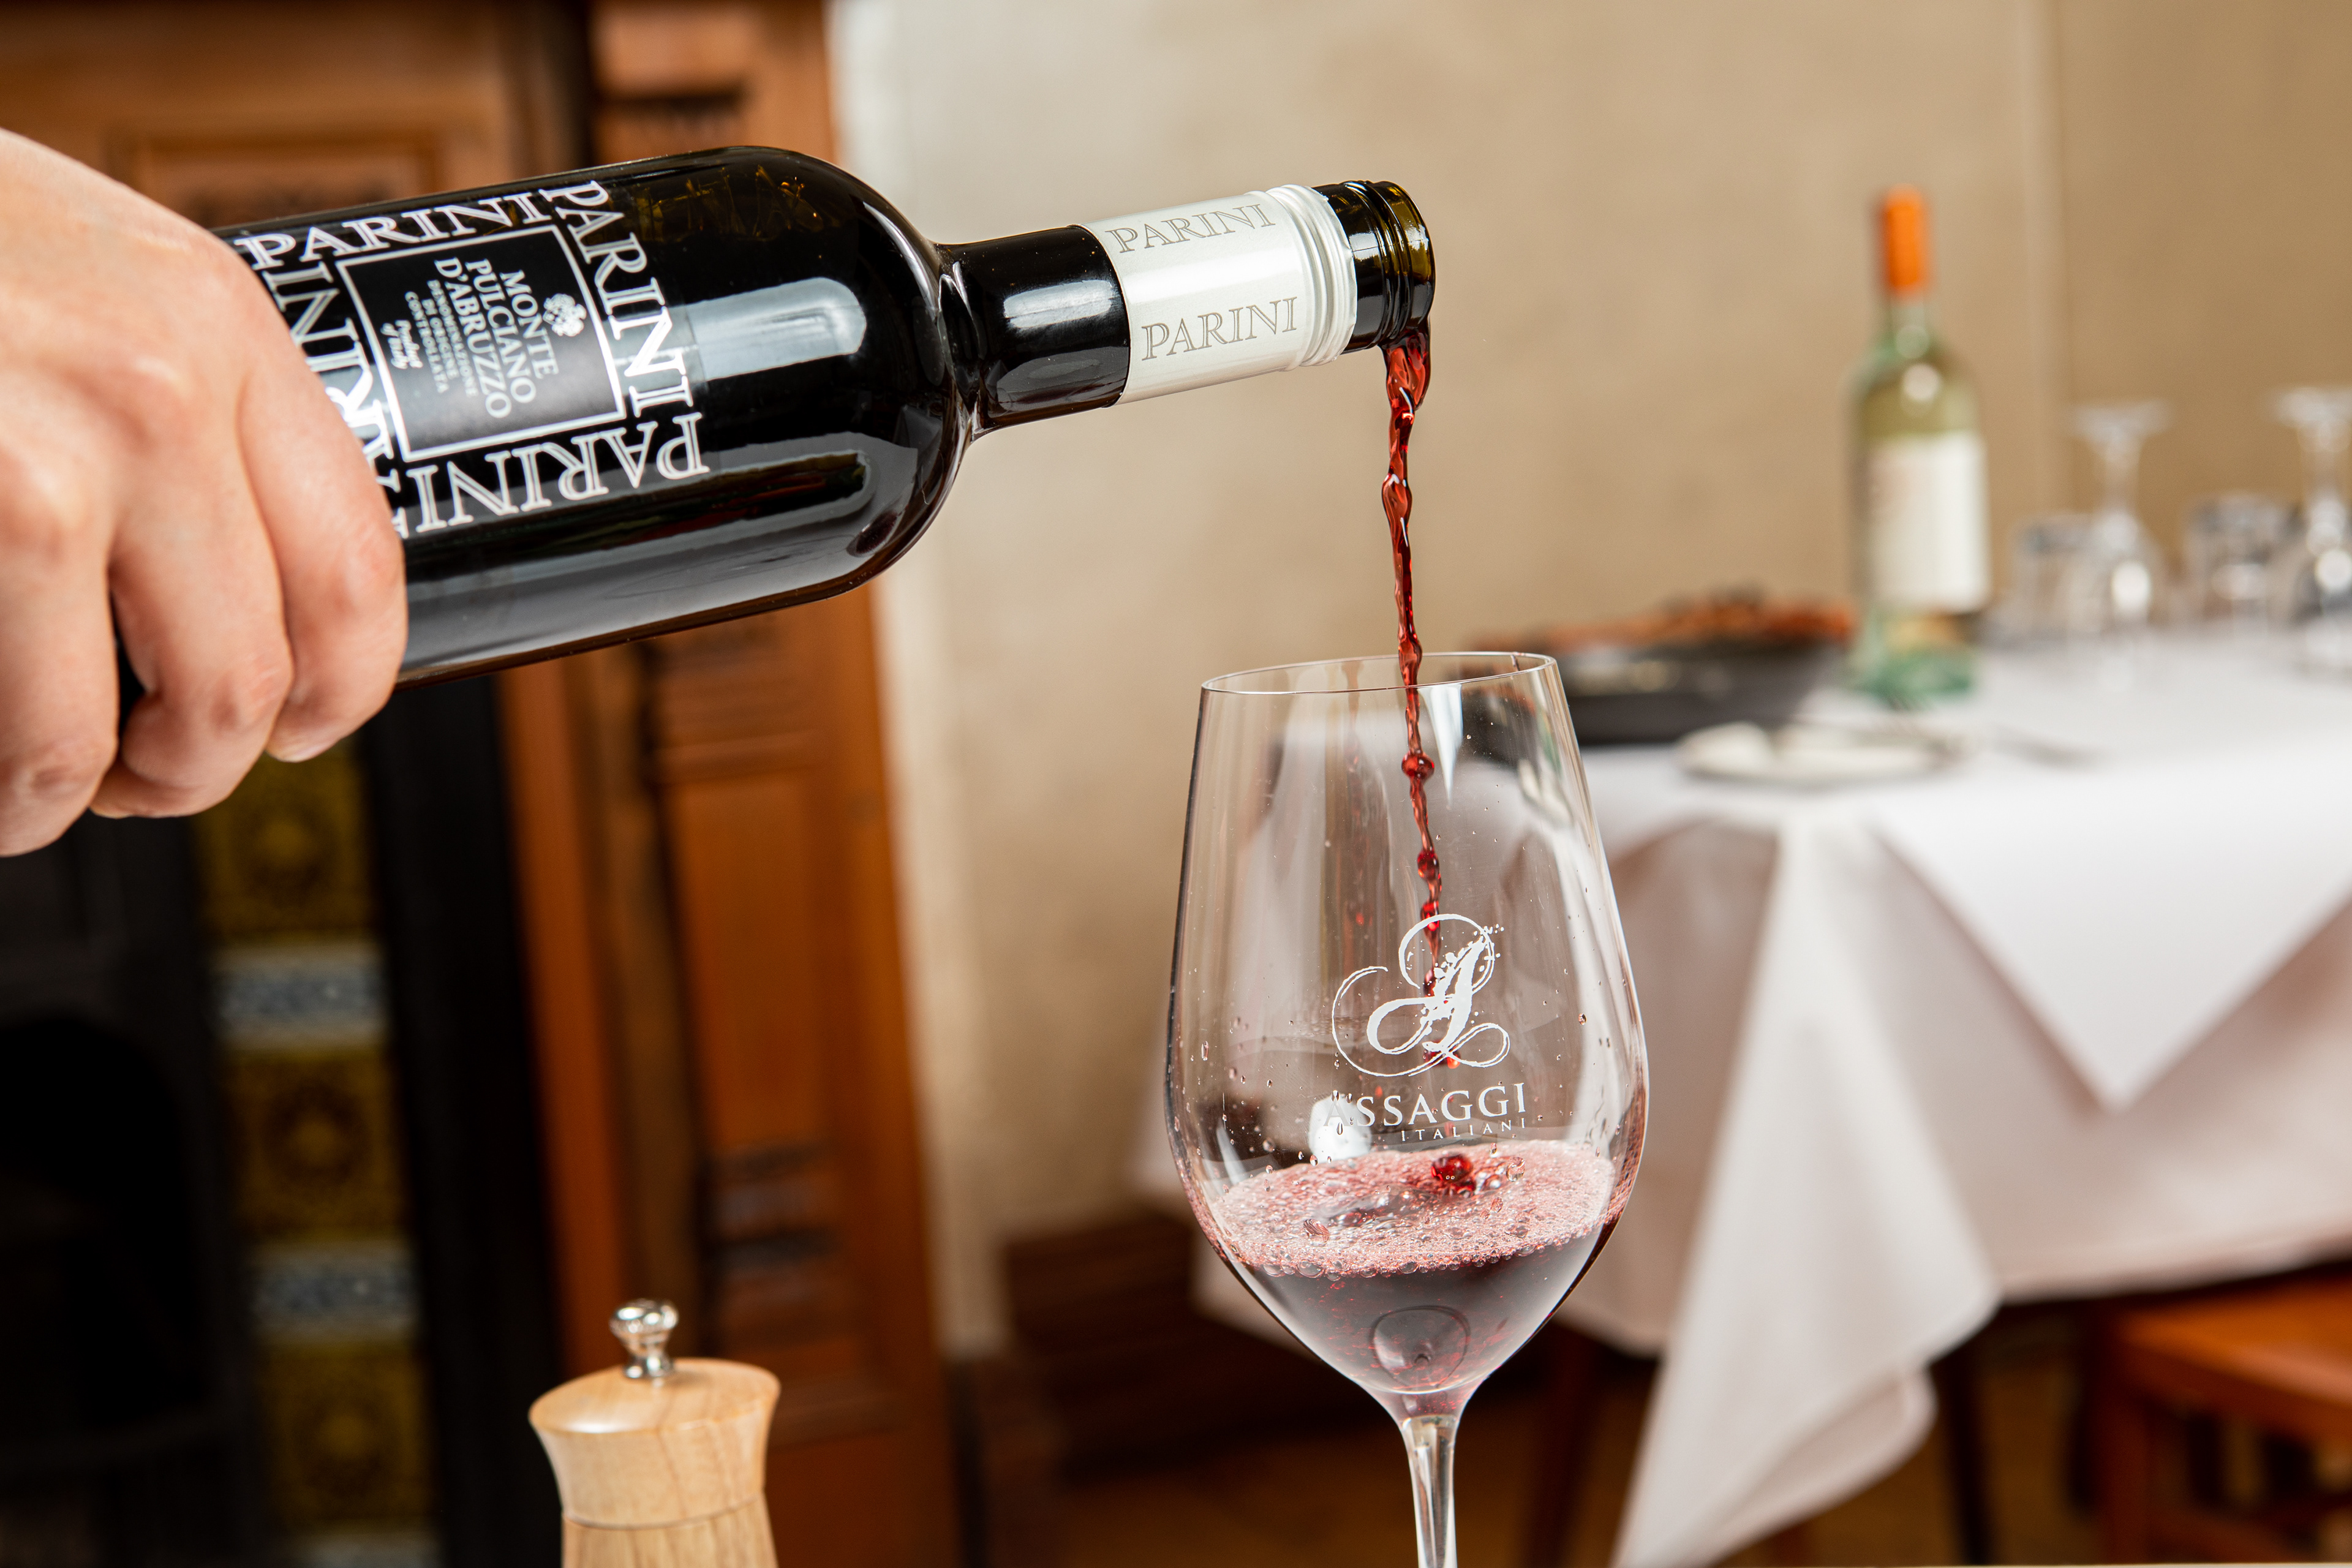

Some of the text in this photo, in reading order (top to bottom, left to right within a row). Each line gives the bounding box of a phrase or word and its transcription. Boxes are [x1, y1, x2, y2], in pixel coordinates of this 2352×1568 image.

[233, 192, 552, 271] PARINI
[1105, 203, 1276, 254] PARINI
[405, 291, 450, 394] CONTROLLATA
[427, 279, 479, 397] DENOMINAZIONE
[434, 257, 513, 418] D'ABRUZZO
[464, 258, 537, 404] PULCIANO
[499, 270, 559, 379] MONTE
[538, 180, 693, 418] PARINI
[1141, 296, 1298, 361] PARINI
[406, 412, 710, 533] PARINI
[1323, 1082, 1526, 1127] ASSAGGI
[1401, 1117, 1525, 1142] ITALIANI
